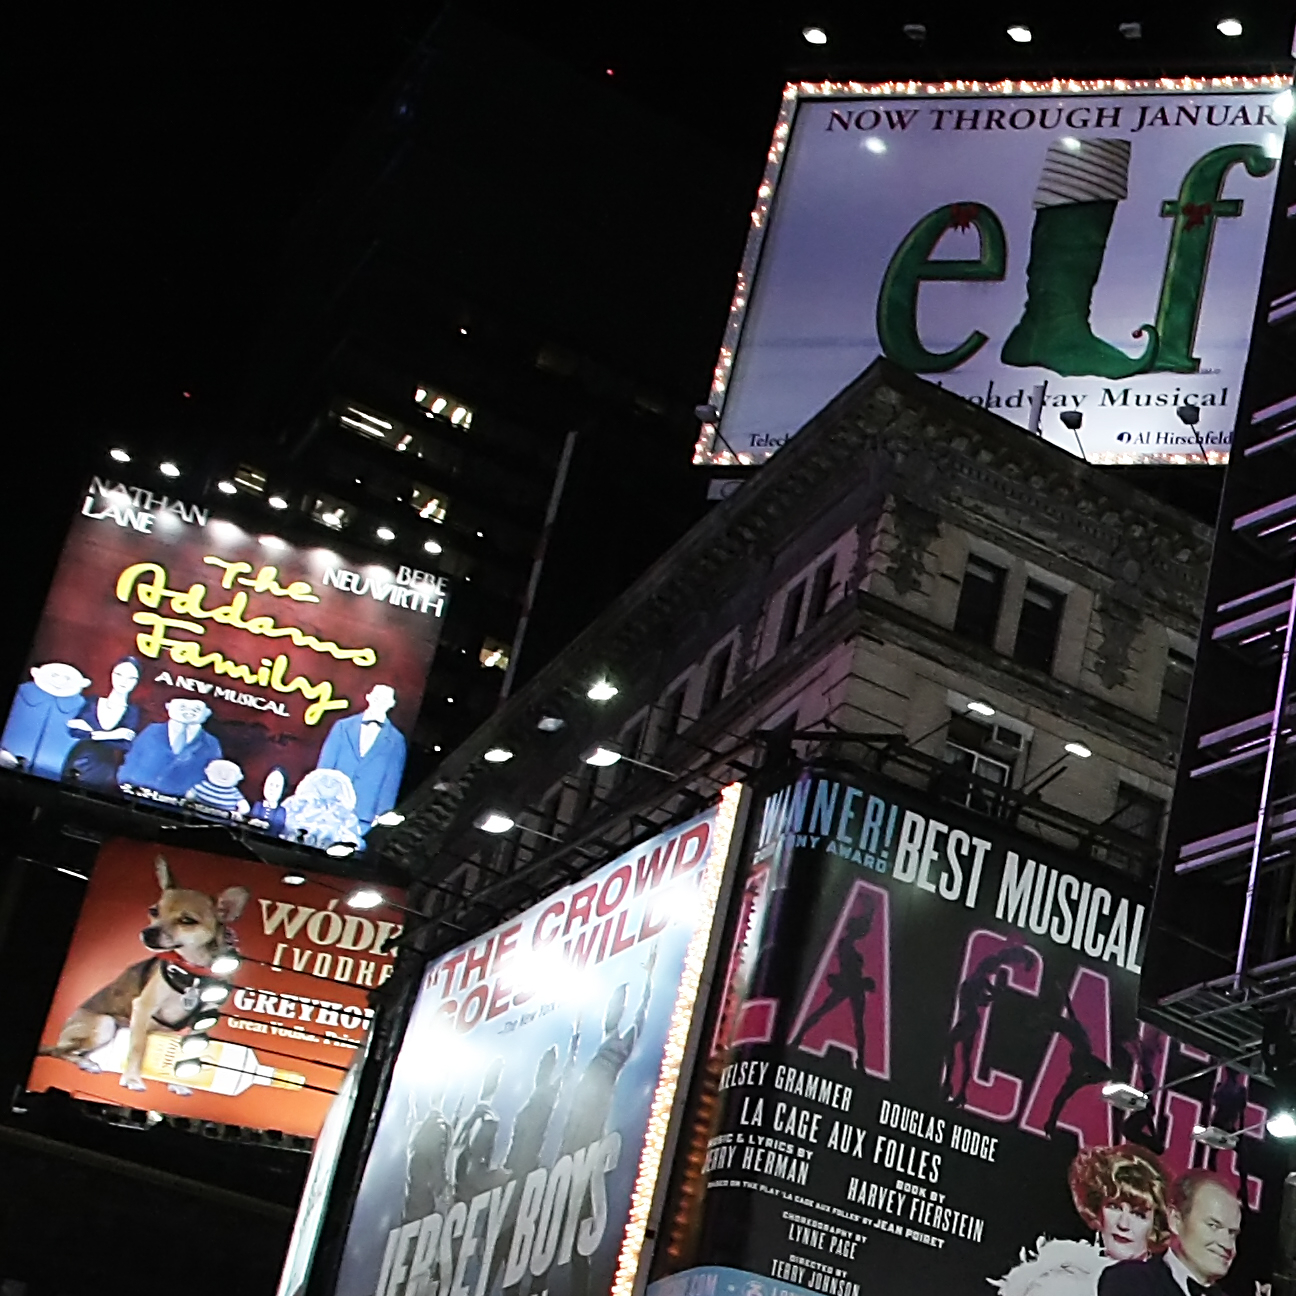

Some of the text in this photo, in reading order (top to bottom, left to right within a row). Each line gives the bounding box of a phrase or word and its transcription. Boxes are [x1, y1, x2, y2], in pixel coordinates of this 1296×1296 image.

[825, 109, 919, 131] NOW
[931, 106, 1120, 131] THROUGH
[1098, 388, 1228, 408] Musical
[82, 497, 156, 534] LANE
[90, 476, 208, 527] NATHAN
[202, 556, 320, 604] The
[322, 566, 445, 618] NEUWIRTH
[399, 566, 449, 596] BEBE
[115, 563, 377, 667] Addams
[133, 612, 349, 725] Family
[154, 671, 290, 717] A NEW MUSICAL
[825, 840, 888, 874] AWARD
[532, 822, 711, 951] CROWD
[893, 809, 1147, 975] BEST MUSICAL
[775, 1065, 853, 1112] GRAMMER
[740, 1096, 942, 1184] LA CAGE AUX FOLLES
[748, 1134, 814, 1160] LYRICS BY
[879, 1099, 999, 1163] DOUGLAS HODGE
[742, 1147, 810, 1186] HERMAN
[502, 1138, 620, 1289] BOYS
[847, 1176, 986, 1243] HARVEY FIERSTEIN
[929, 1190, 947, 1204] BY
[788, 1223, 859, 1261] LYNNE PAGE
[873, 1218, 946, 1249] JEAN POIRET
[771, 1258, 805, 1285] TERRY
